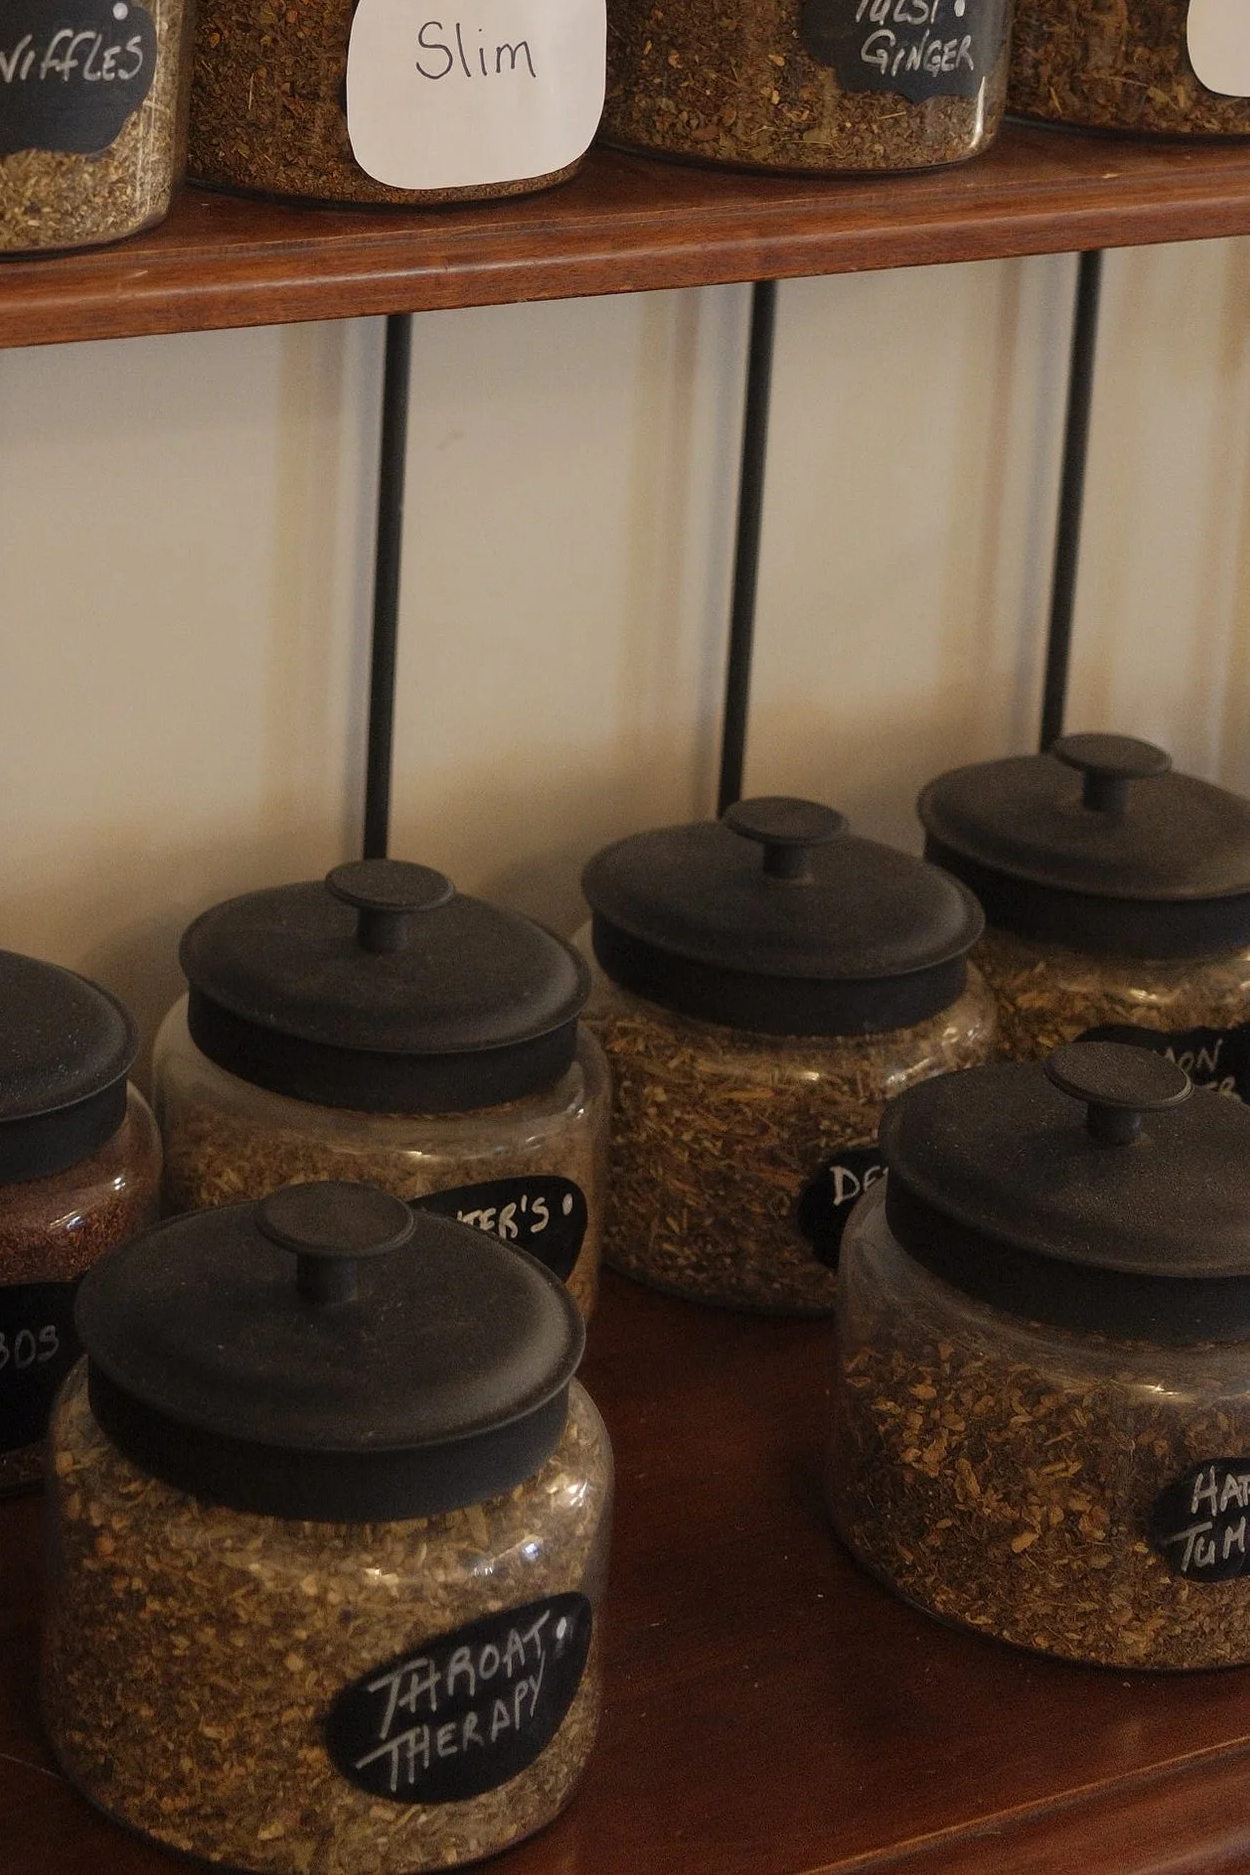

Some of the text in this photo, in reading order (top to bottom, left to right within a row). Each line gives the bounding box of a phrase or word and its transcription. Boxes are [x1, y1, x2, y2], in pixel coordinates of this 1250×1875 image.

[415, 20, 537, 80] Slim
[860, 28, 975, 78] GINGER
[354, 1650, 548, 1793] THERAPY
[367, 1609, 551, 1742] THROAT
